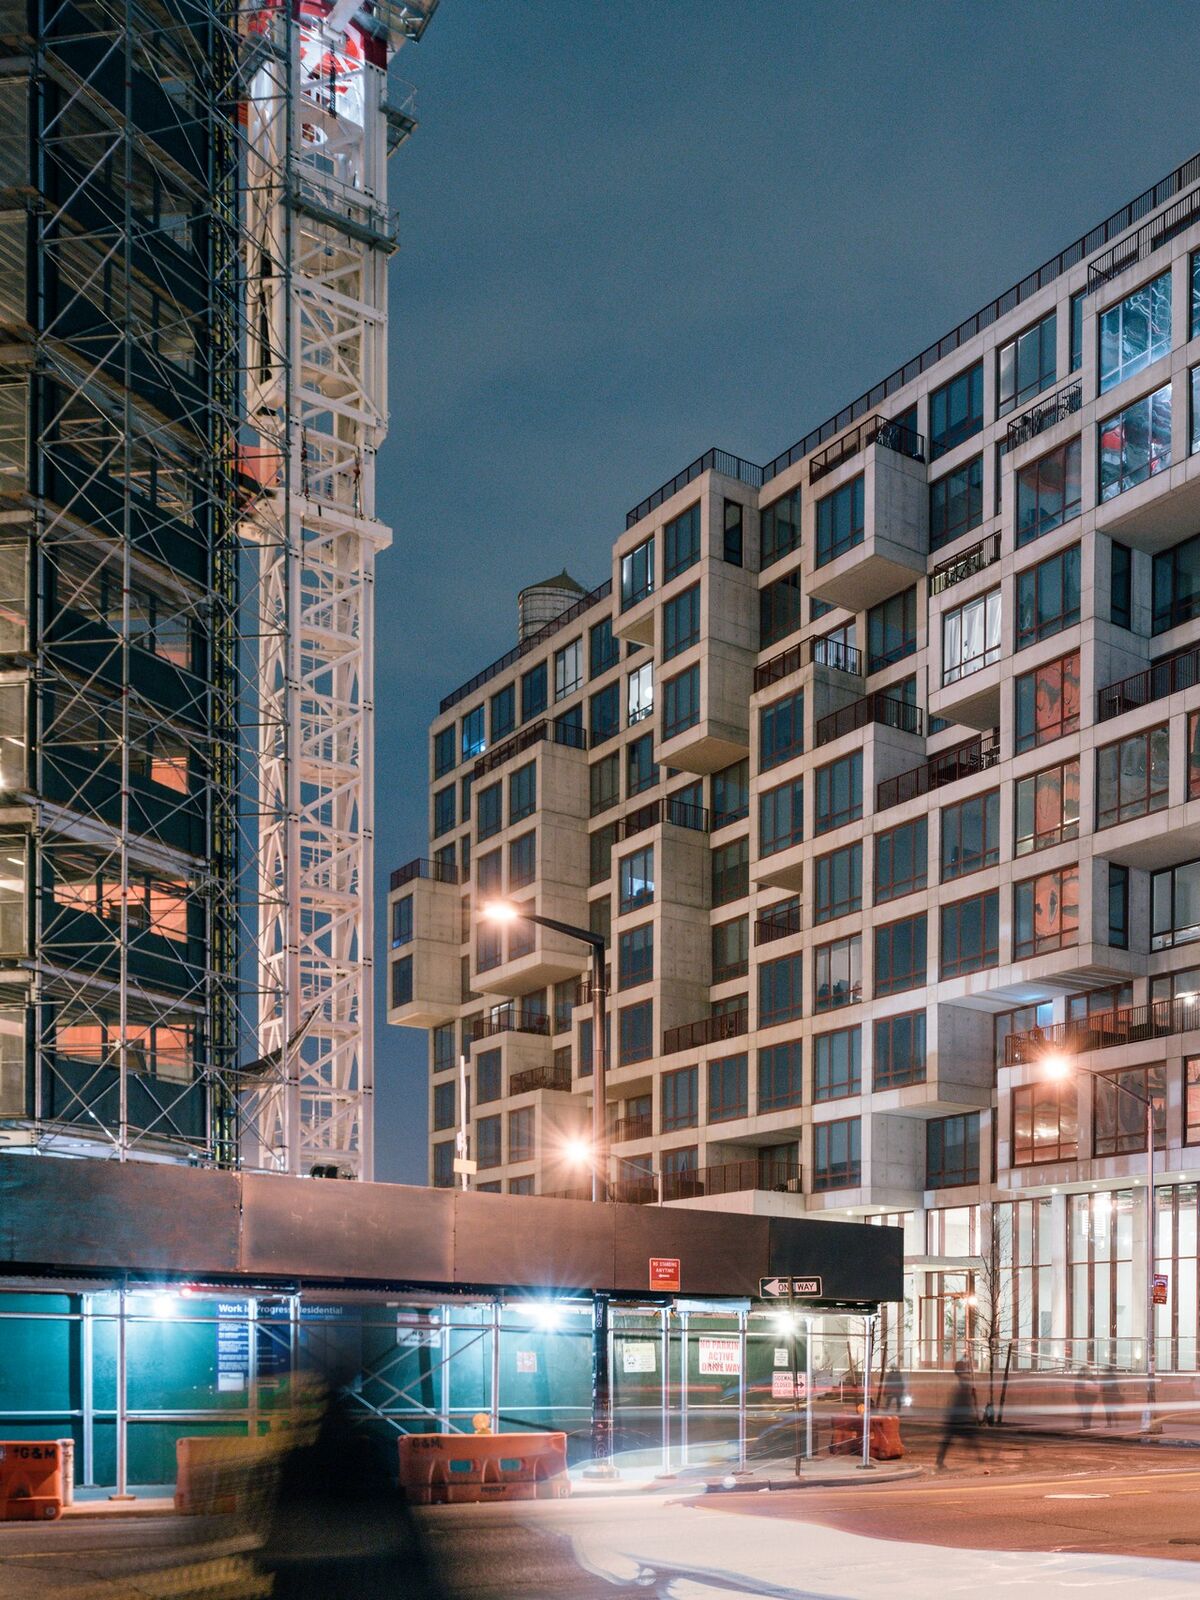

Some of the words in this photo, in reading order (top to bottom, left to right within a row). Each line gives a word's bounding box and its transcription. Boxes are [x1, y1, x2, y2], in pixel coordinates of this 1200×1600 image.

[797, 1283, 815, 1291] WAY
[218, 1304, 242, 1313] Work
[300, 1306, 343, 1315] esidential
[712, 1340, 740, 1350] PARKIN
